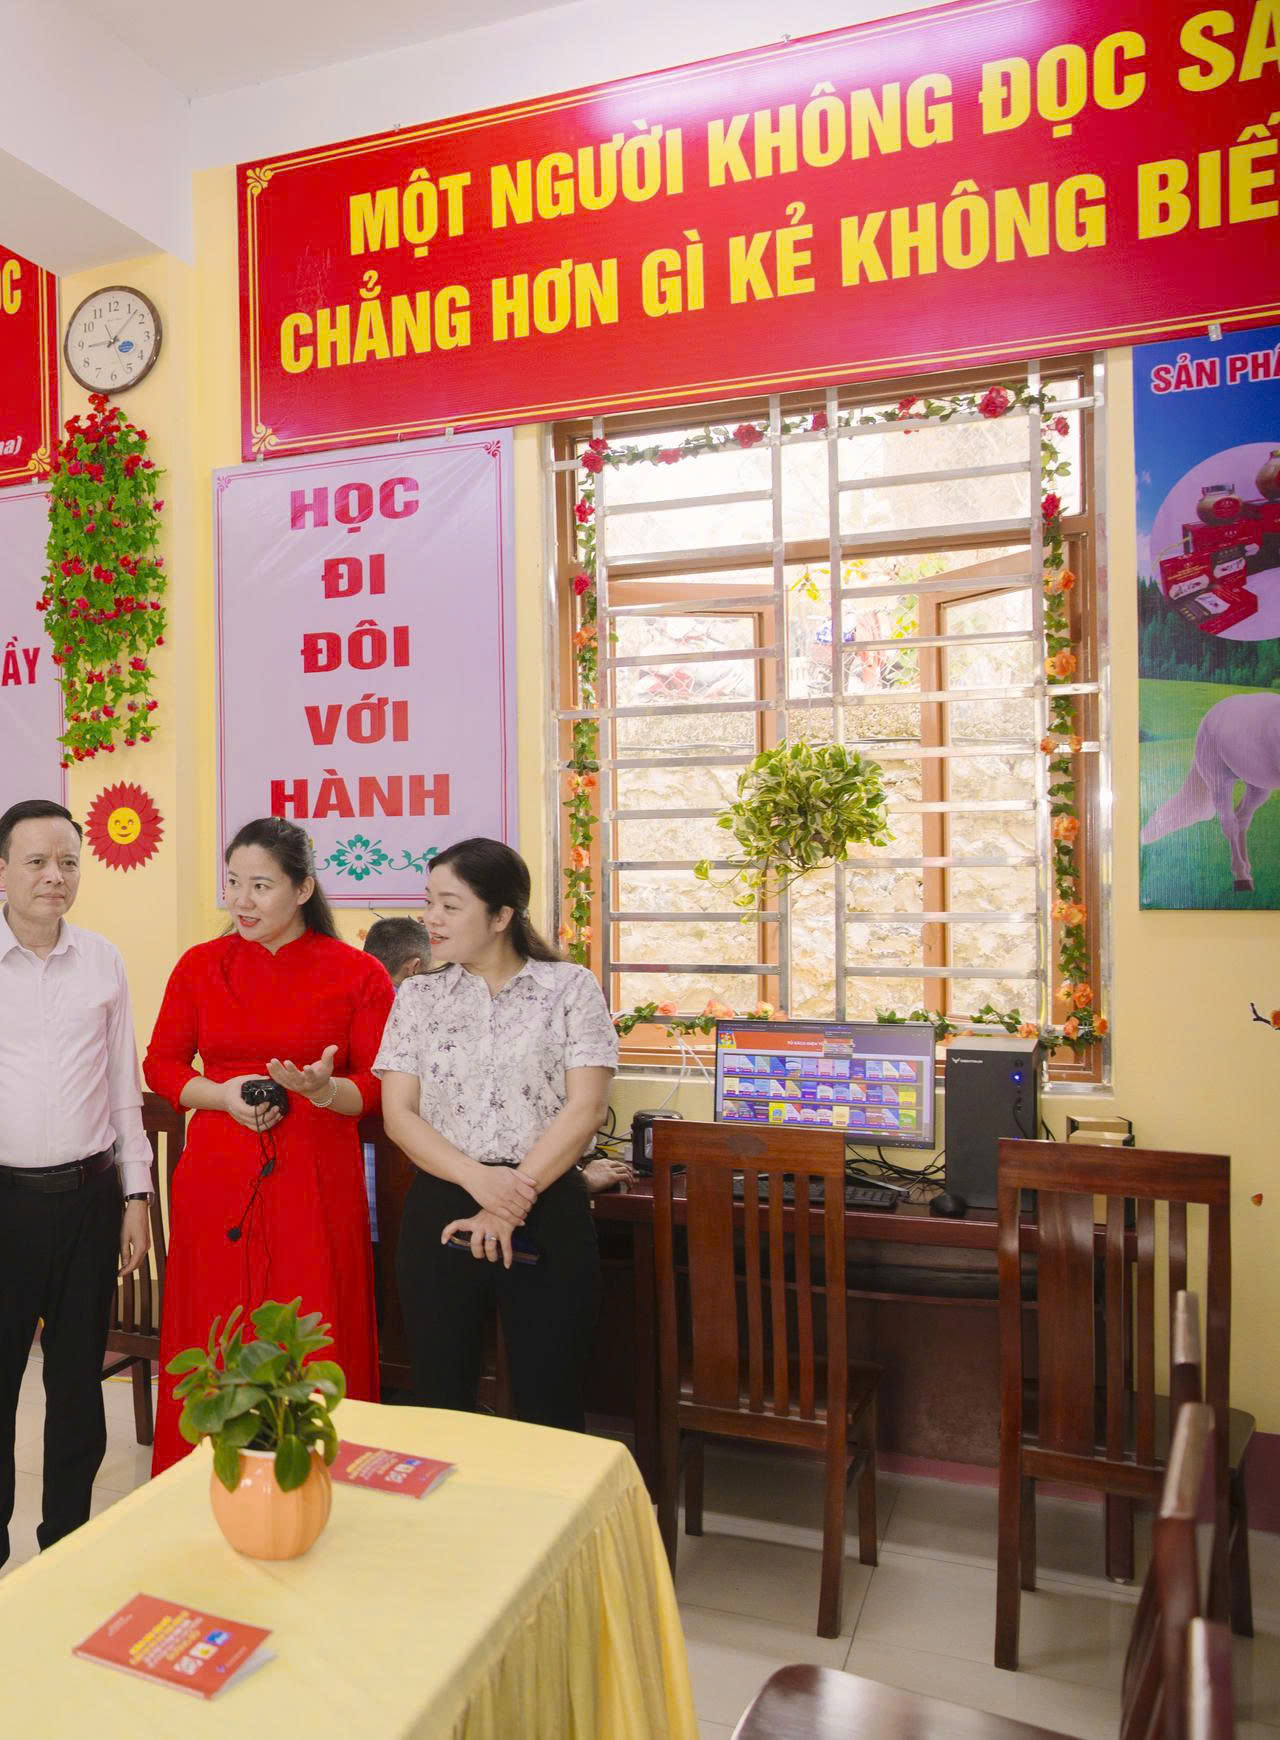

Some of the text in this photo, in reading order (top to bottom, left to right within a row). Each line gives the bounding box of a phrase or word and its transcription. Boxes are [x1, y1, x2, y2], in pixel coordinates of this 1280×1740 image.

[350, 169, 471, 258] MỘT
[490, 118, 684, 228] NGƯỜI
[708, 81, 954, 187] KHÔNG
[979, 31, 1146, 137] ĐỌC
[280, 269, 472, 374] CHẲNG
[492, 258, 619, 341] HƠN
[642, 230, 705, 317] GÌ
[729, 202, 816, 304] KẺ
[841, 180, 1107, 287] KHÔNG
[93, 308, 103, 320] 11
[108, 301, 120, 313] 12
[138, 313, 146, 325] 2
[83, 321, 95, 333] 10
[78, 340, 85, 350] 9
[82, 357, 90, 369] 8
[94, 367, 102, 378] 7
[110, 370, 118, 381] 6
[1151, 354, 1219, 394] SẢN
[288, 475, 422, 536] HỌC
[320, 552, 387, 601] ĐI
[298, 618, 411, 676] ĐÔI
[304, 692, 410, 747] VỚI
[270, 768, 451, 820] HÀNH
